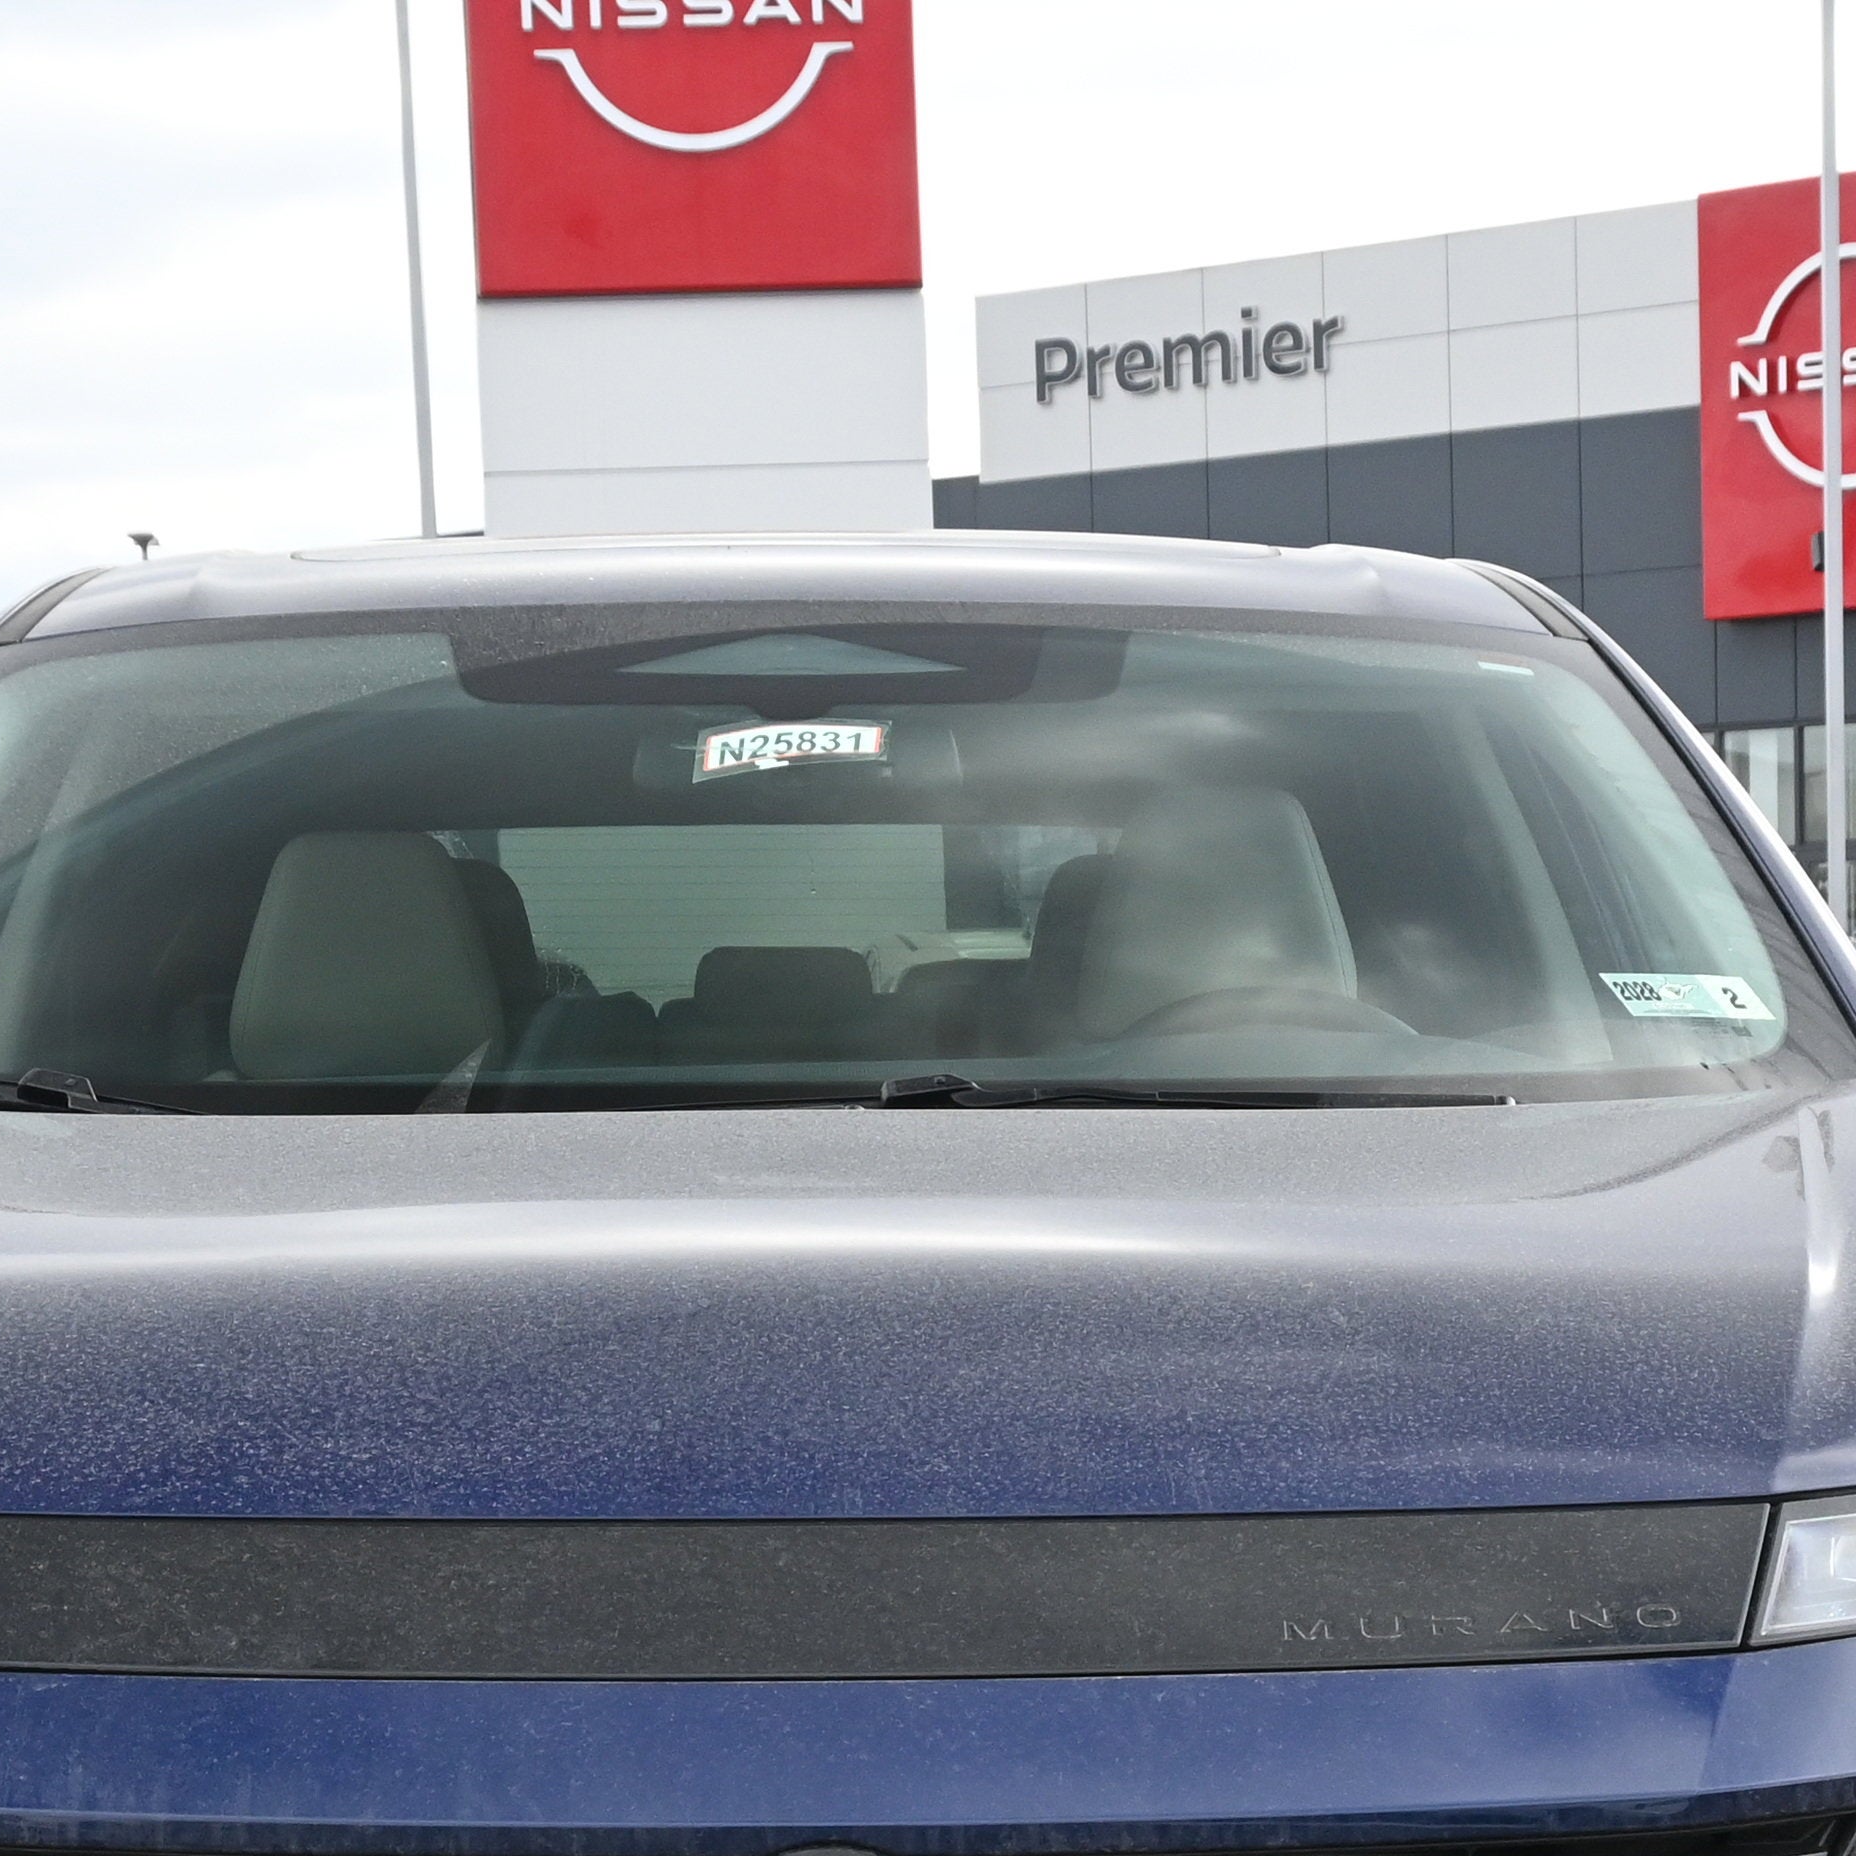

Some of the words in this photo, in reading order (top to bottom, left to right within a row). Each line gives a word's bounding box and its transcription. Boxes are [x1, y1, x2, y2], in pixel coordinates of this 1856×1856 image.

[521, 0, 864, 31] NISSAN
[1035, 305, 1344, 404] Premier
[719, 731, 863, 765] N25831
[1612, 981, 1662, 1001] 2028
[1721, 987, 1748, 1010] 2
[1282, 1603, 1680, 1641] MURANO
